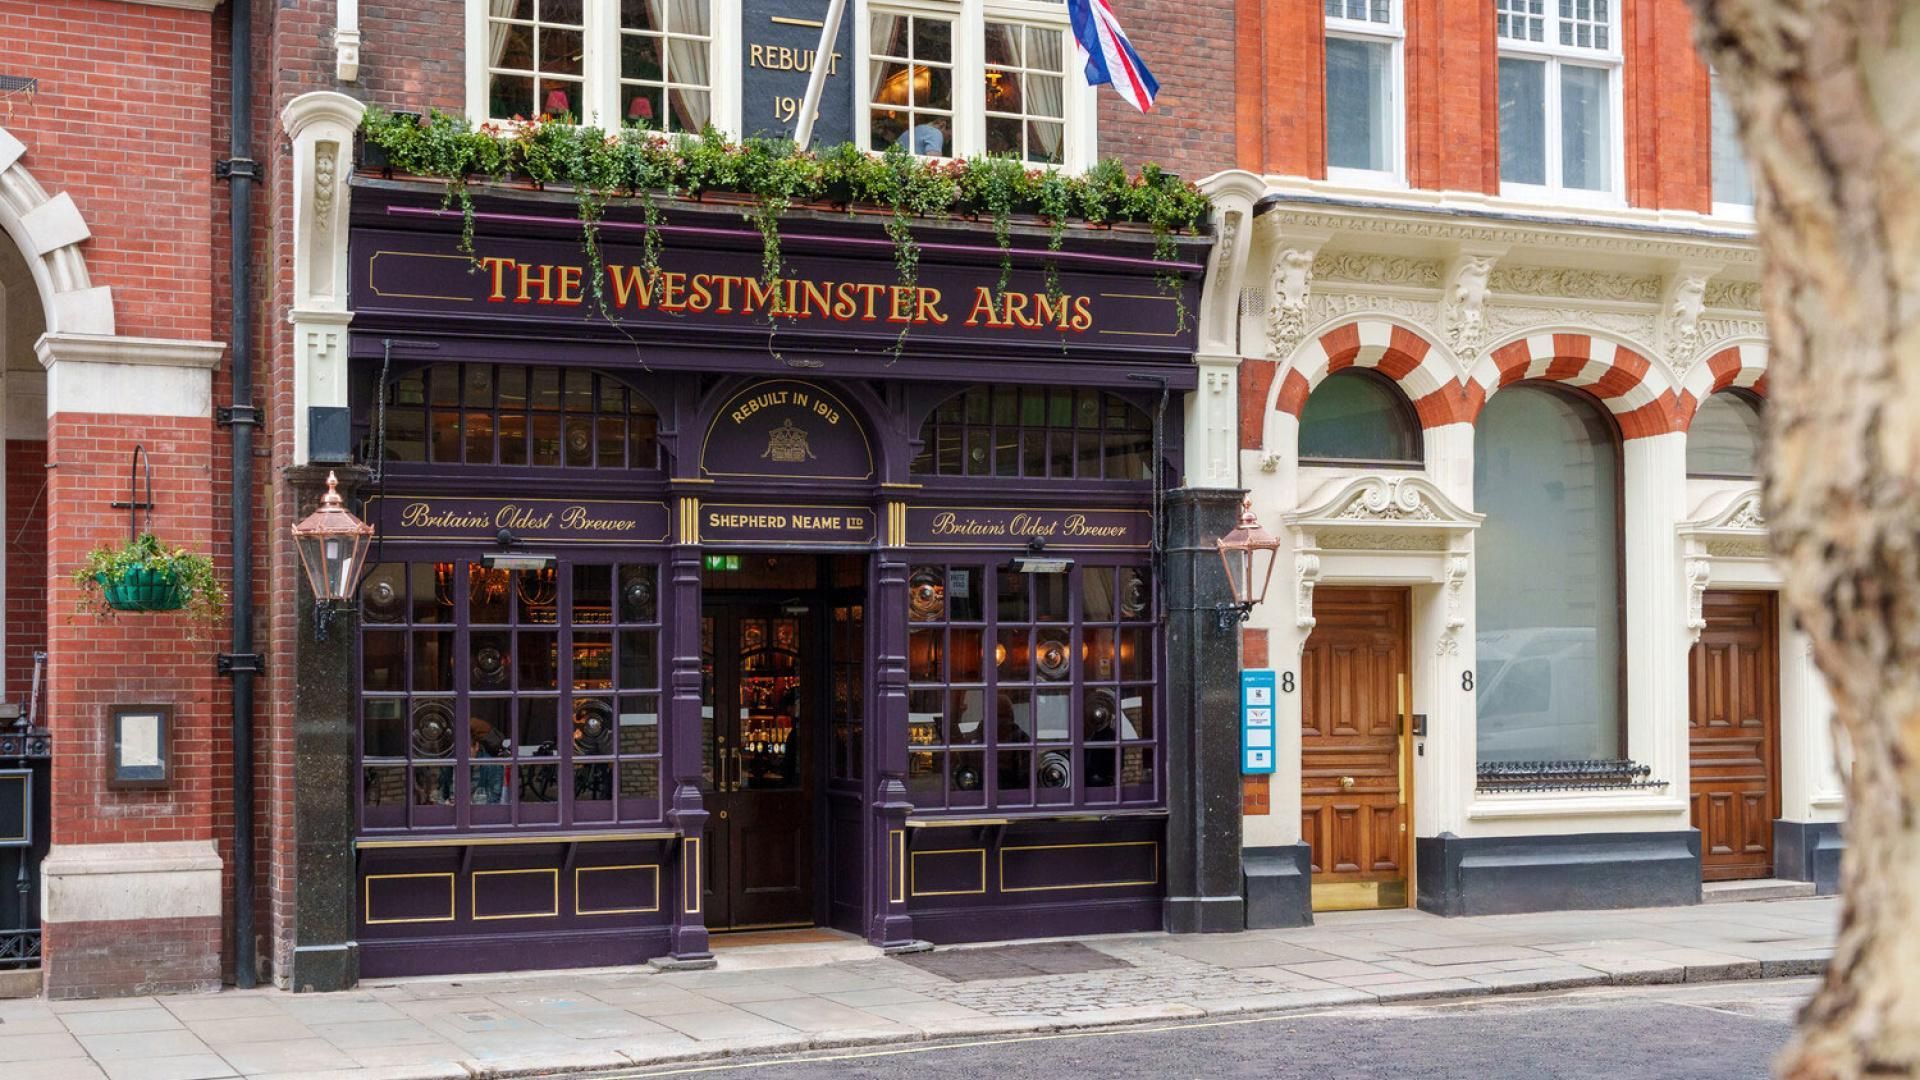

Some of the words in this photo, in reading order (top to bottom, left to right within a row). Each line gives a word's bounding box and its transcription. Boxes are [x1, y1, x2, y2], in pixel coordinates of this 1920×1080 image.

[750, 43, 841, 75] REBUIT
[775, 96, 819, 122] 191
[481, 256, 583, 304] THE
[608, 264, 948, 324] WESTMINSTER
[964, 287, 1093, 332] ARMS
[732, 391, 788, 424] REBUILT
[793, 392, 808, 407] IN
[813, 400, 840, 425] 1913
[401, 503, 489, 528] Britain's
[495, 504, 553, 530] Oldest
[559, 506, 637, 531] Brewer
[709, 513, 787, 528] SHEPHERD
[792, 515, 841, 530] NEAME
[846, 517, 864, 530] LTD
[932, 512, 1005, 536] Britain's
[1009, 513, 1059, 537] Oldest
[1063, 514, 1128, 537] Brewer
[1282, 671, 1295, 692] 8
[1462, 670, 1473, 692] 8
